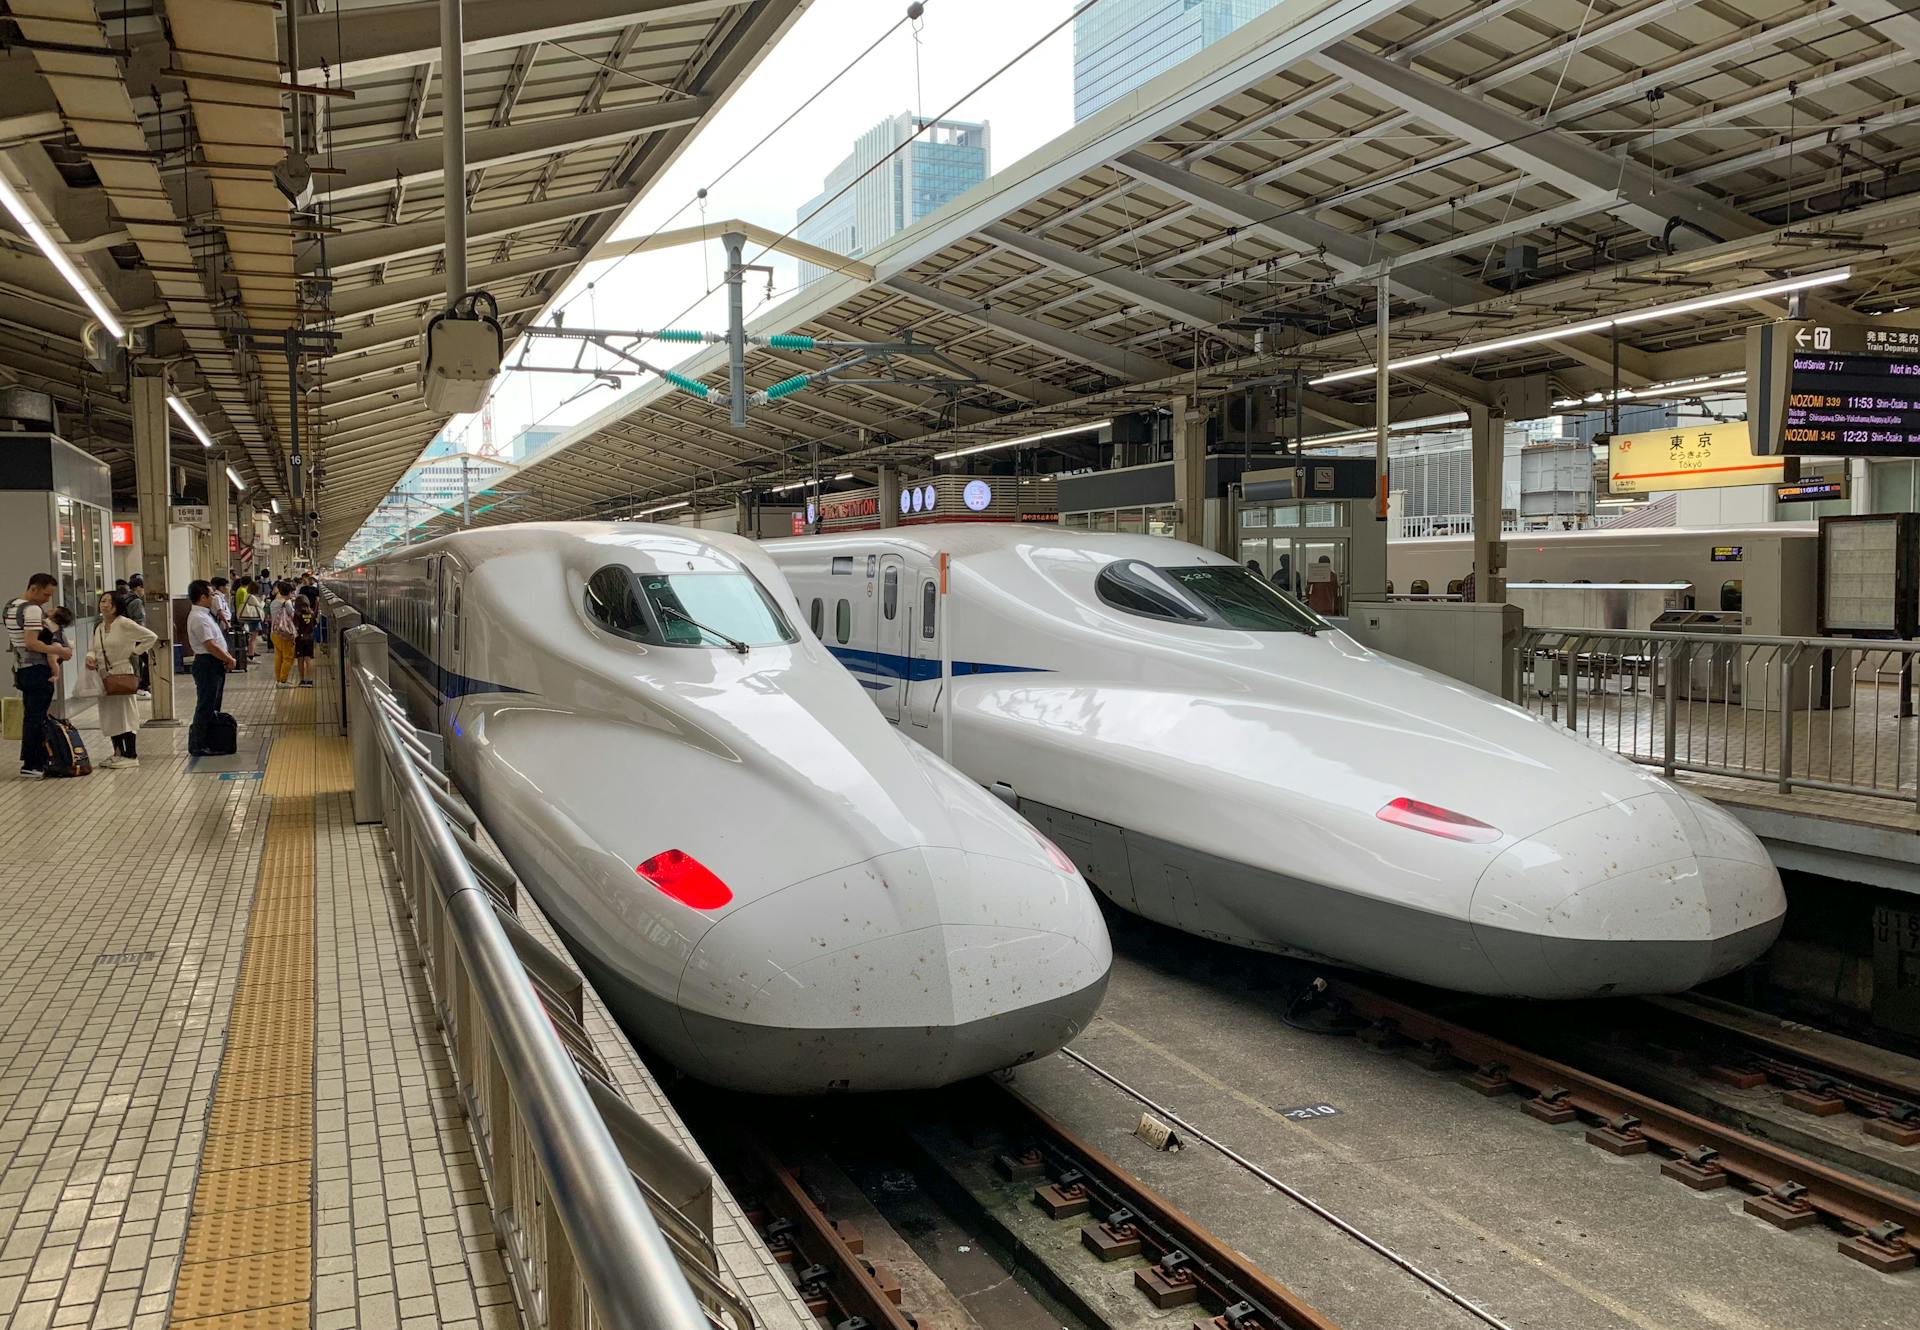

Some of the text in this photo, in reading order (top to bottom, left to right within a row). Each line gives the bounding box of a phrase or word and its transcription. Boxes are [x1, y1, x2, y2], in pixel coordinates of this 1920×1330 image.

[1816, 331, 1829, 347] 17
[1867, 331, 1919, 345] 発車ご案内
[1866, 343, 1883, 351] Train
[1884, 344, 1919, 353] Departures
[1829, 361, 1844, 371] 717
[1890, 363, 1904, 375] Not
[1904, 364, 1912, 375] in
[1790, 395, 1824, 408] NOZOMI
[1826, 397, 1841, 407] 339
[1848, 397, 1873, 409] 11:53
[1669, 431, 1713, 451] 東京
[1784, 429, 1819, 442] NOZOMI
[1820, 431, 1836, 441] 345
[1843, 430, 1868, 442] 12:23
[1619, 440, 1632, 450] JR
[290, 455, 301, 465] 16
[1669, 449, 1711, 461] とうきょう
